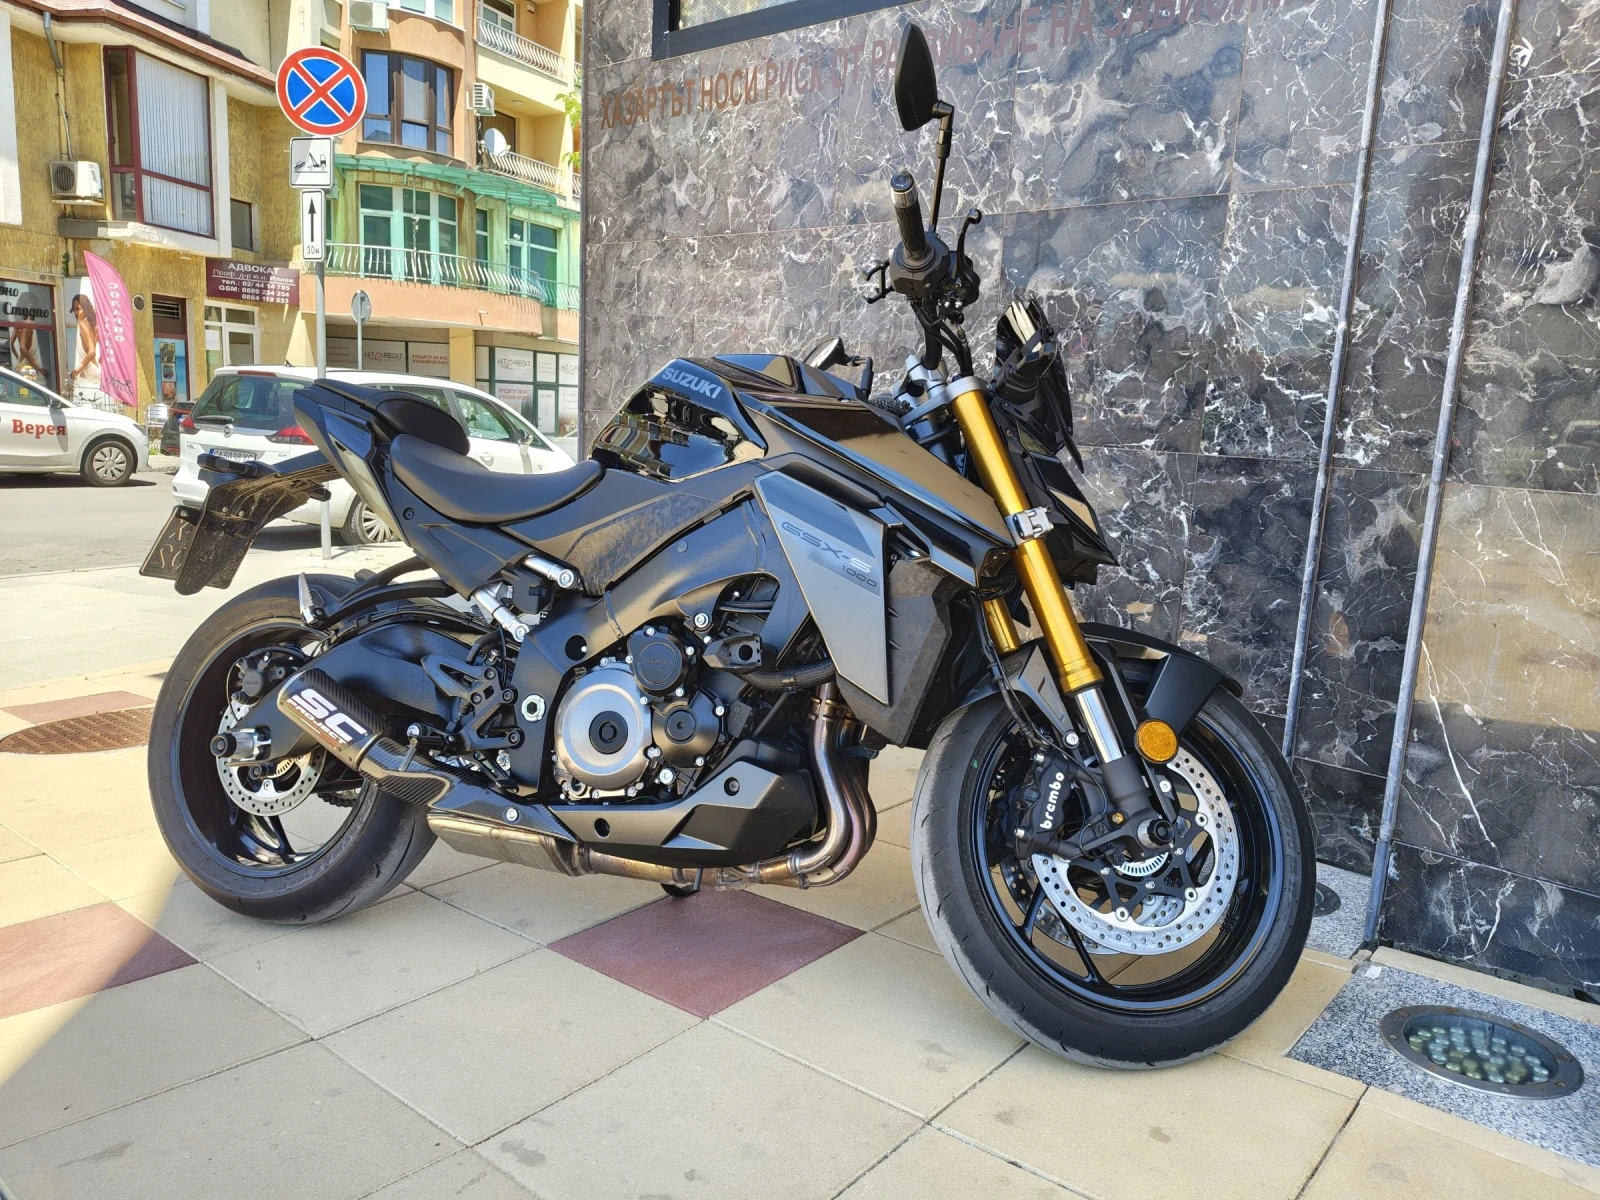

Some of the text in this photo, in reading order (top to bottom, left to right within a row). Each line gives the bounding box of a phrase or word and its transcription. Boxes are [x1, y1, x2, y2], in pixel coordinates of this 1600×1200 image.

[600, 79, 696, 130] ХАЗАРТЪТ
[701, 66, 758, 113] НОСИ
[765, 50, 822, 100] РИСК
[831, 44, 865, 89] ОТ
[872, 6, 1041, 82] РАИВАНЕ
[1051, 0, 1094, 48] НА
[212, 269, 238, 278] Проф.
[228, 263, 279, 275] АДВОКАТ
[219, 285, 240, 293] GSM:
[3, 302, 50, 320] Студио
[661, 367, 722, 400] SUZUKI
[12, 419, 66, 439] Верея
[781, 521, 872, 574] GSX-S
[842, 565, 878, 588] 1000
[286, 698, 347, 744] PROJECT
[291, 688, 368, 742] SC
[1040, 772, 1064, 830] brembo
